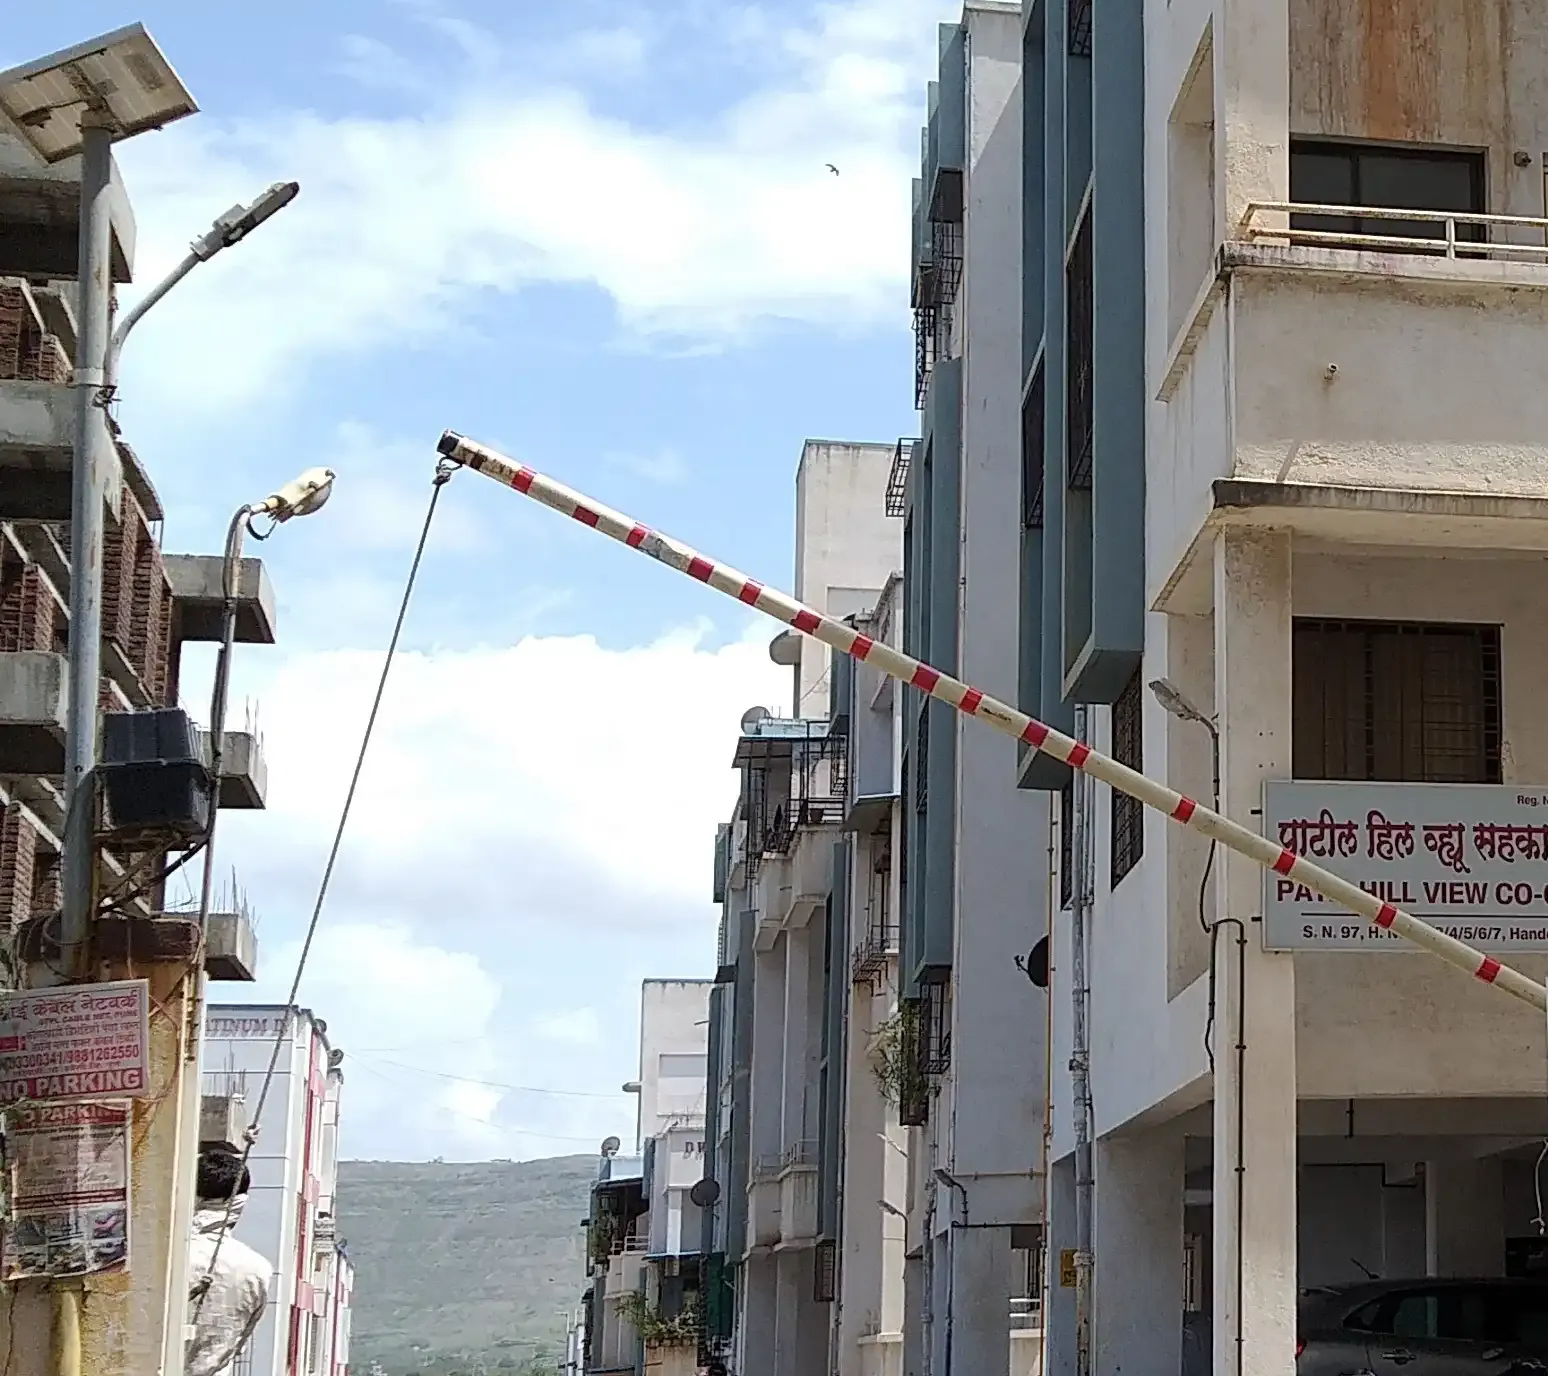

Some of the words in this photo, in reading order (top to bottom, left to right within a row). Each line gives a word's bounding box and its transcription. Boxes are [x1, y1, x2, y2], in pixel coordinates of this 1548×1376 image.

[1517, 795, 1539, 808] Reg.
[1278, 808, 1359, 858] पाटील
[1366, 809, 1415, 861] हिल
[1422, 822, 1472, 874] व्ह्यू
[1359, 880, 1417, 904] HILL
[1423, 881, 1488, 905] VIEW
[1303, 926, 1318, 938] S.
[1322, 926, 1339, 938] N.
[1341, 926, 1364, 941] 97,
[1368, 926, 1383, 938] H.
[81, 989, 139, 1011] नेटवर्क
[0, 1081, 28, 1100] NO
[35, 1069, 141, 1097] PARKING
